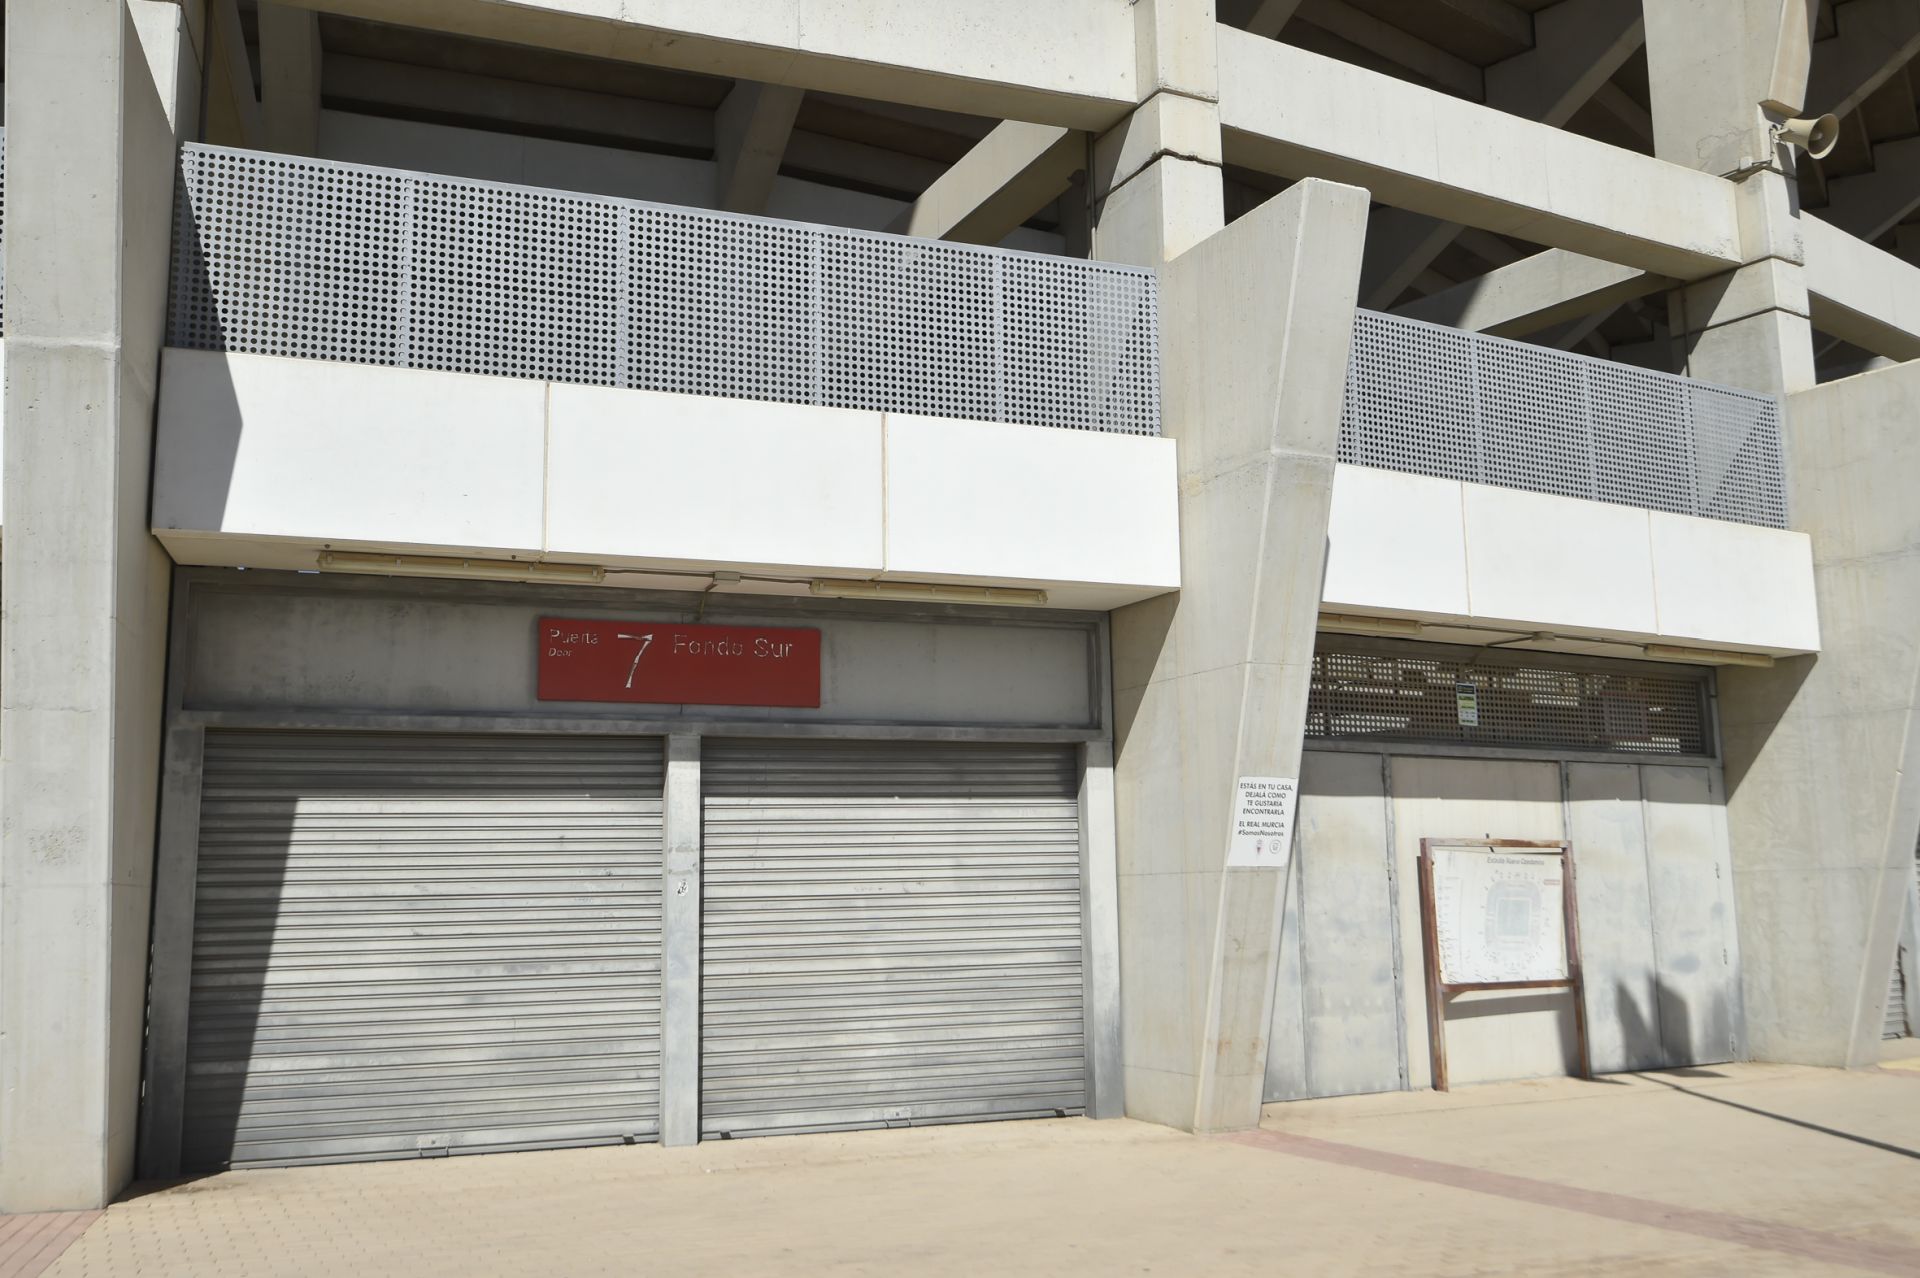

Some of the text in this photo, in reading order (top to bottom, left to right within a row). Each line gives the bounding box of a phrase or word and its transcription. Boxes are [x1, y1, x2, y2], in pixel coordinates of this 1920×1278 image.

[550, 629, 599, 646] Puerta
[673, 634, 793, 658] Fondo Sur
[548, 647, 572, 657] Door
[617, 633, 653, 688] 7
